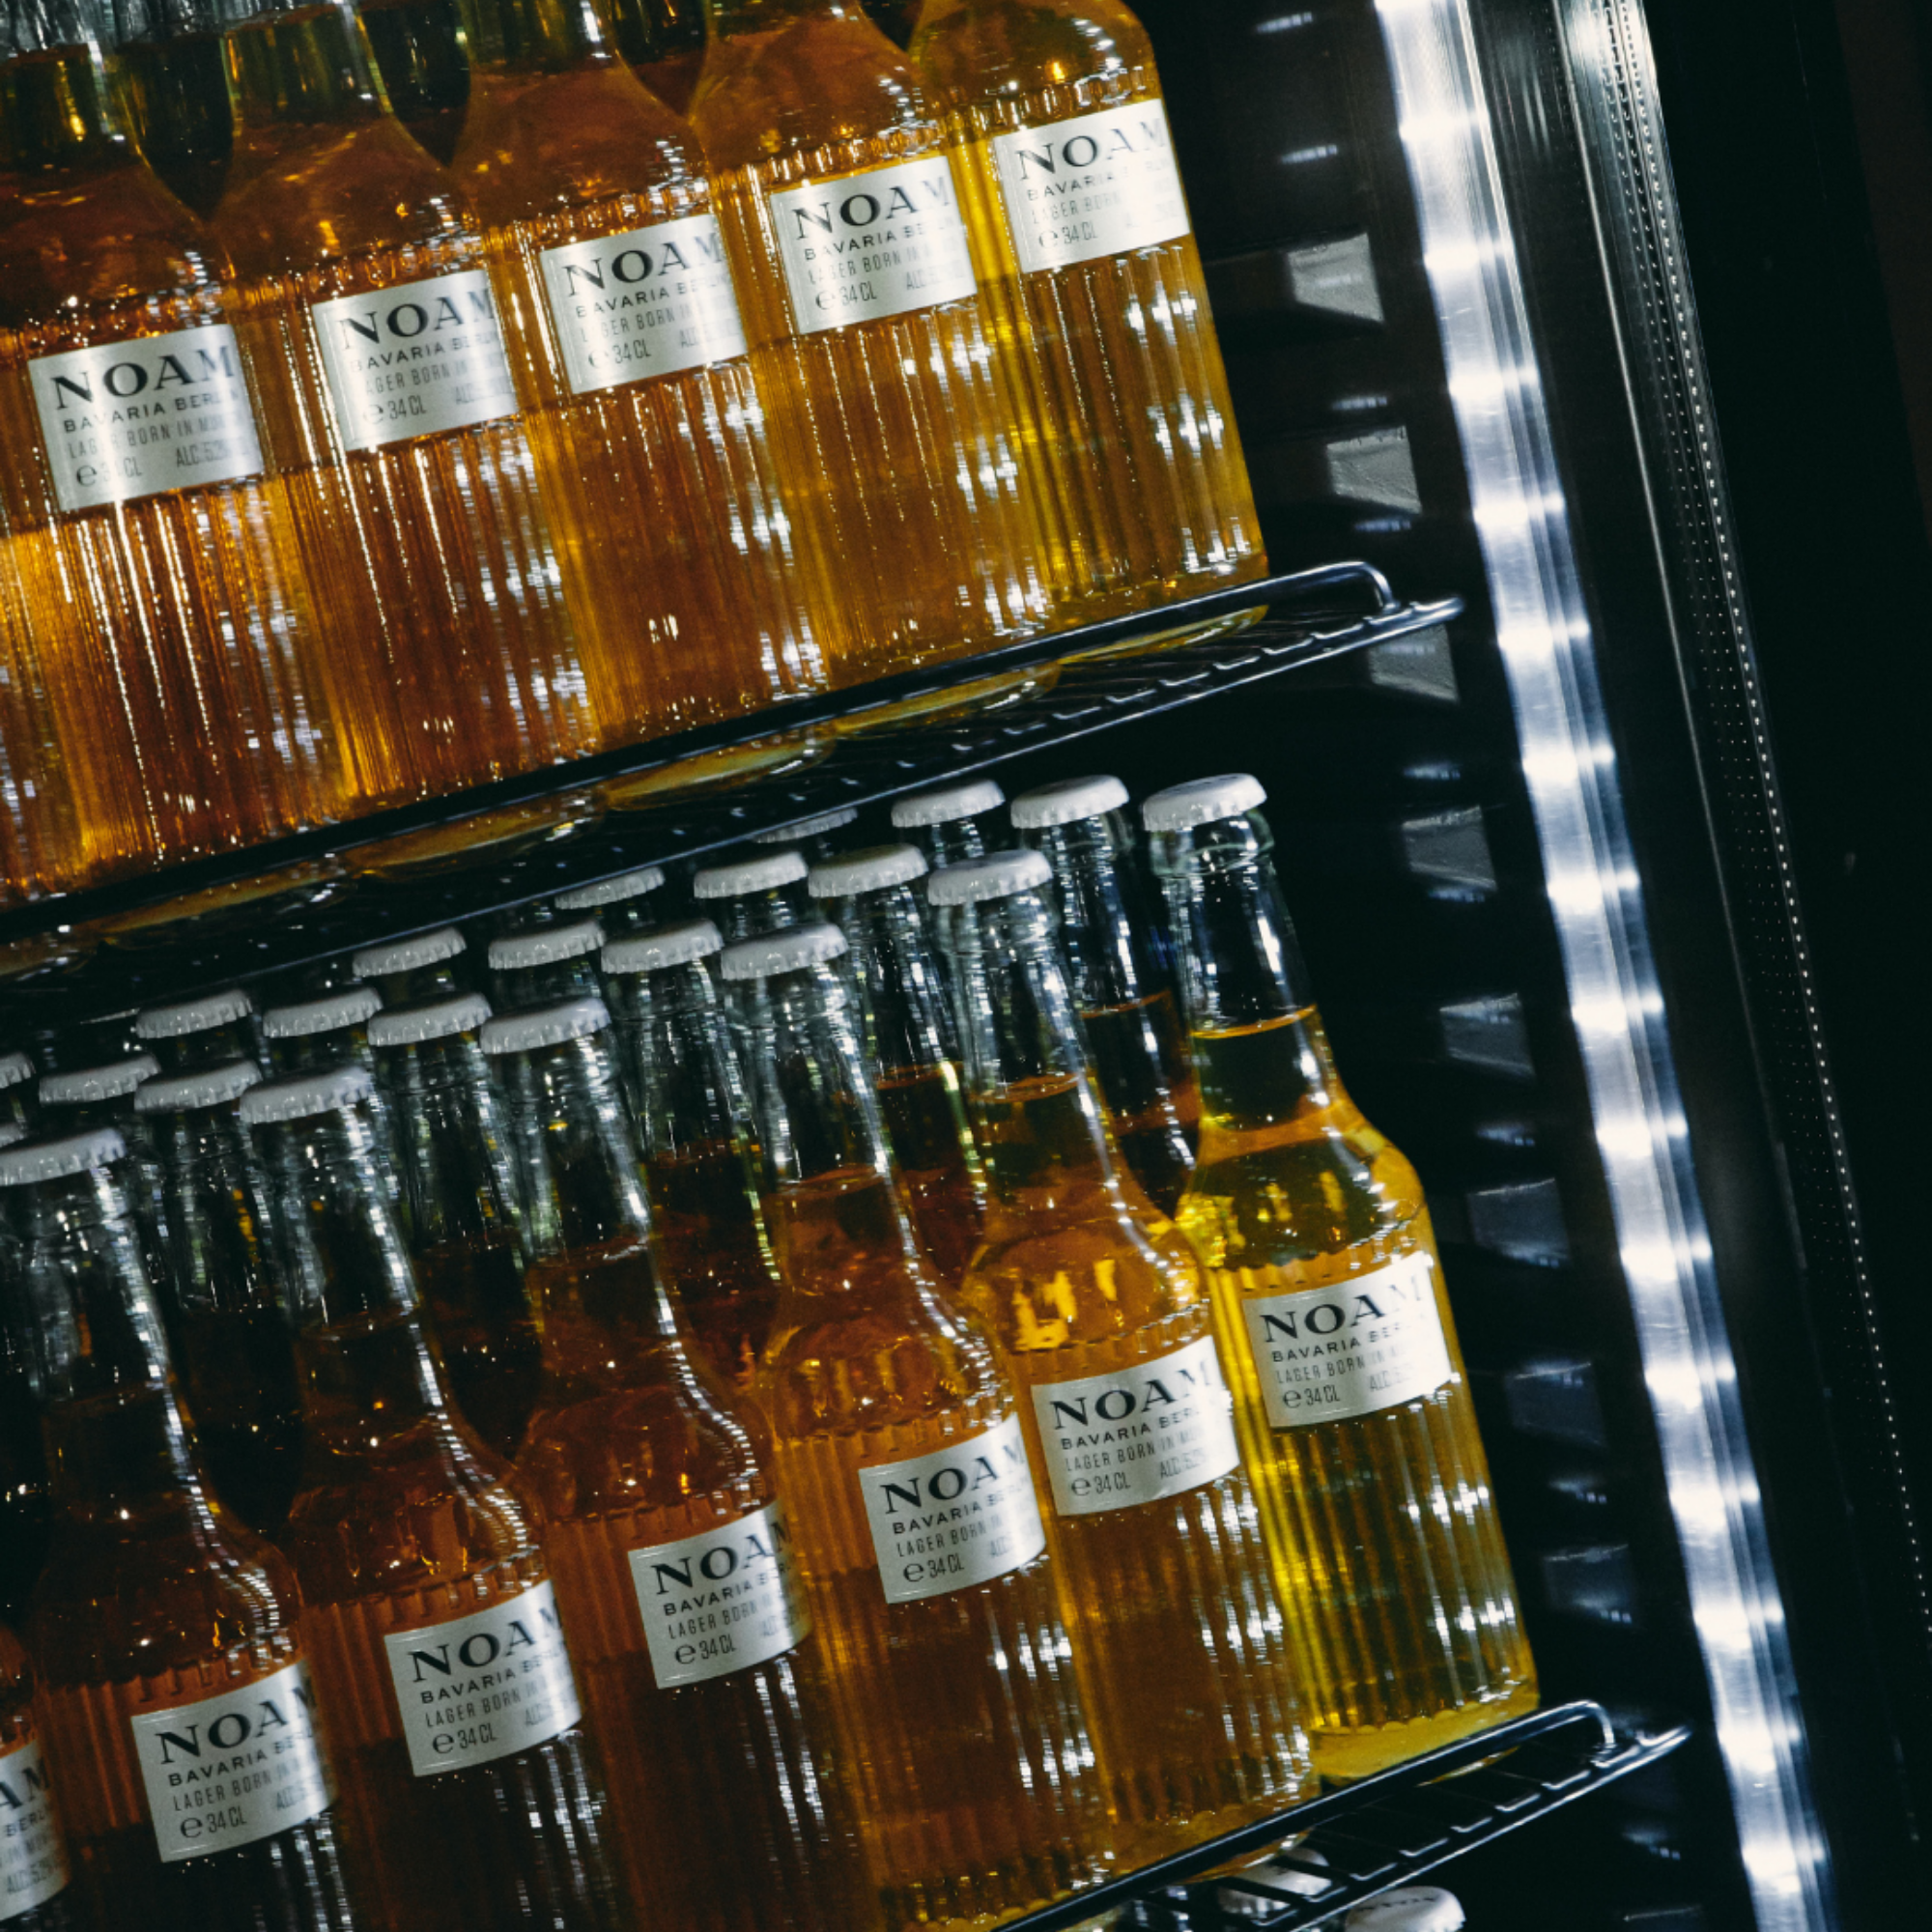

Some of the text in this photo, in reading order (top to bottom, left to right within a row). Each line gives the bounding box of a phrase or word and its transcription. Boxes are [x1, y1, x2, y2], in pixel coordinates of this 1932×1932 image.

[792, 177, 950, 240] NOAM
[562, 233, 723, 298] NOAM
[809, 261, 856, 285] LGER
[863, 250, 900, 272] BORN
[337, 289, 495, 350] NOAM
[581, 318, 630, 342] LGER
[637, 307, 675, 330] BORN
[51, 346, 235, 410] NOAM
[366, 374, 405, 394] AGER
[412, 363, 450, 385] BORN
[68, 438, 119, 459] LAGR
[127, 424, 171, 446] BORN
[1272, 1337, 1361, 1362] BAVARIA
[1276, 1364, 1321, 1384] LAGER
[1327, 1355, 1366, 1377] BORN
[1061, 1423, 1151, 1450] BAVARIA
[1065, 1452, 1110, 1471] LAGER
[1118, 1441, 1155, 1463] BORN
[893, 1500, 982, 1534] BAVARIA
[896, 1534, 946, 1557] LAGER
[952, 1520, 986, 1545] BORN
[663, 1579, 753, 1616] BAVARIA
[668, 1613, 717, 1639] LAGER
[723, 1601, 757, 1624] BORN
[420, 1667, 516, 1704] BAVARIA
[425, 1702, 475, 1728] LAGER
[483, 1688, 522, 1714] BORN
[168, 1749, 268, 1786] BAVARIA
[173, 1784, 225, 1811] LAGER
[232, 1770, 271, 1797] BORN
